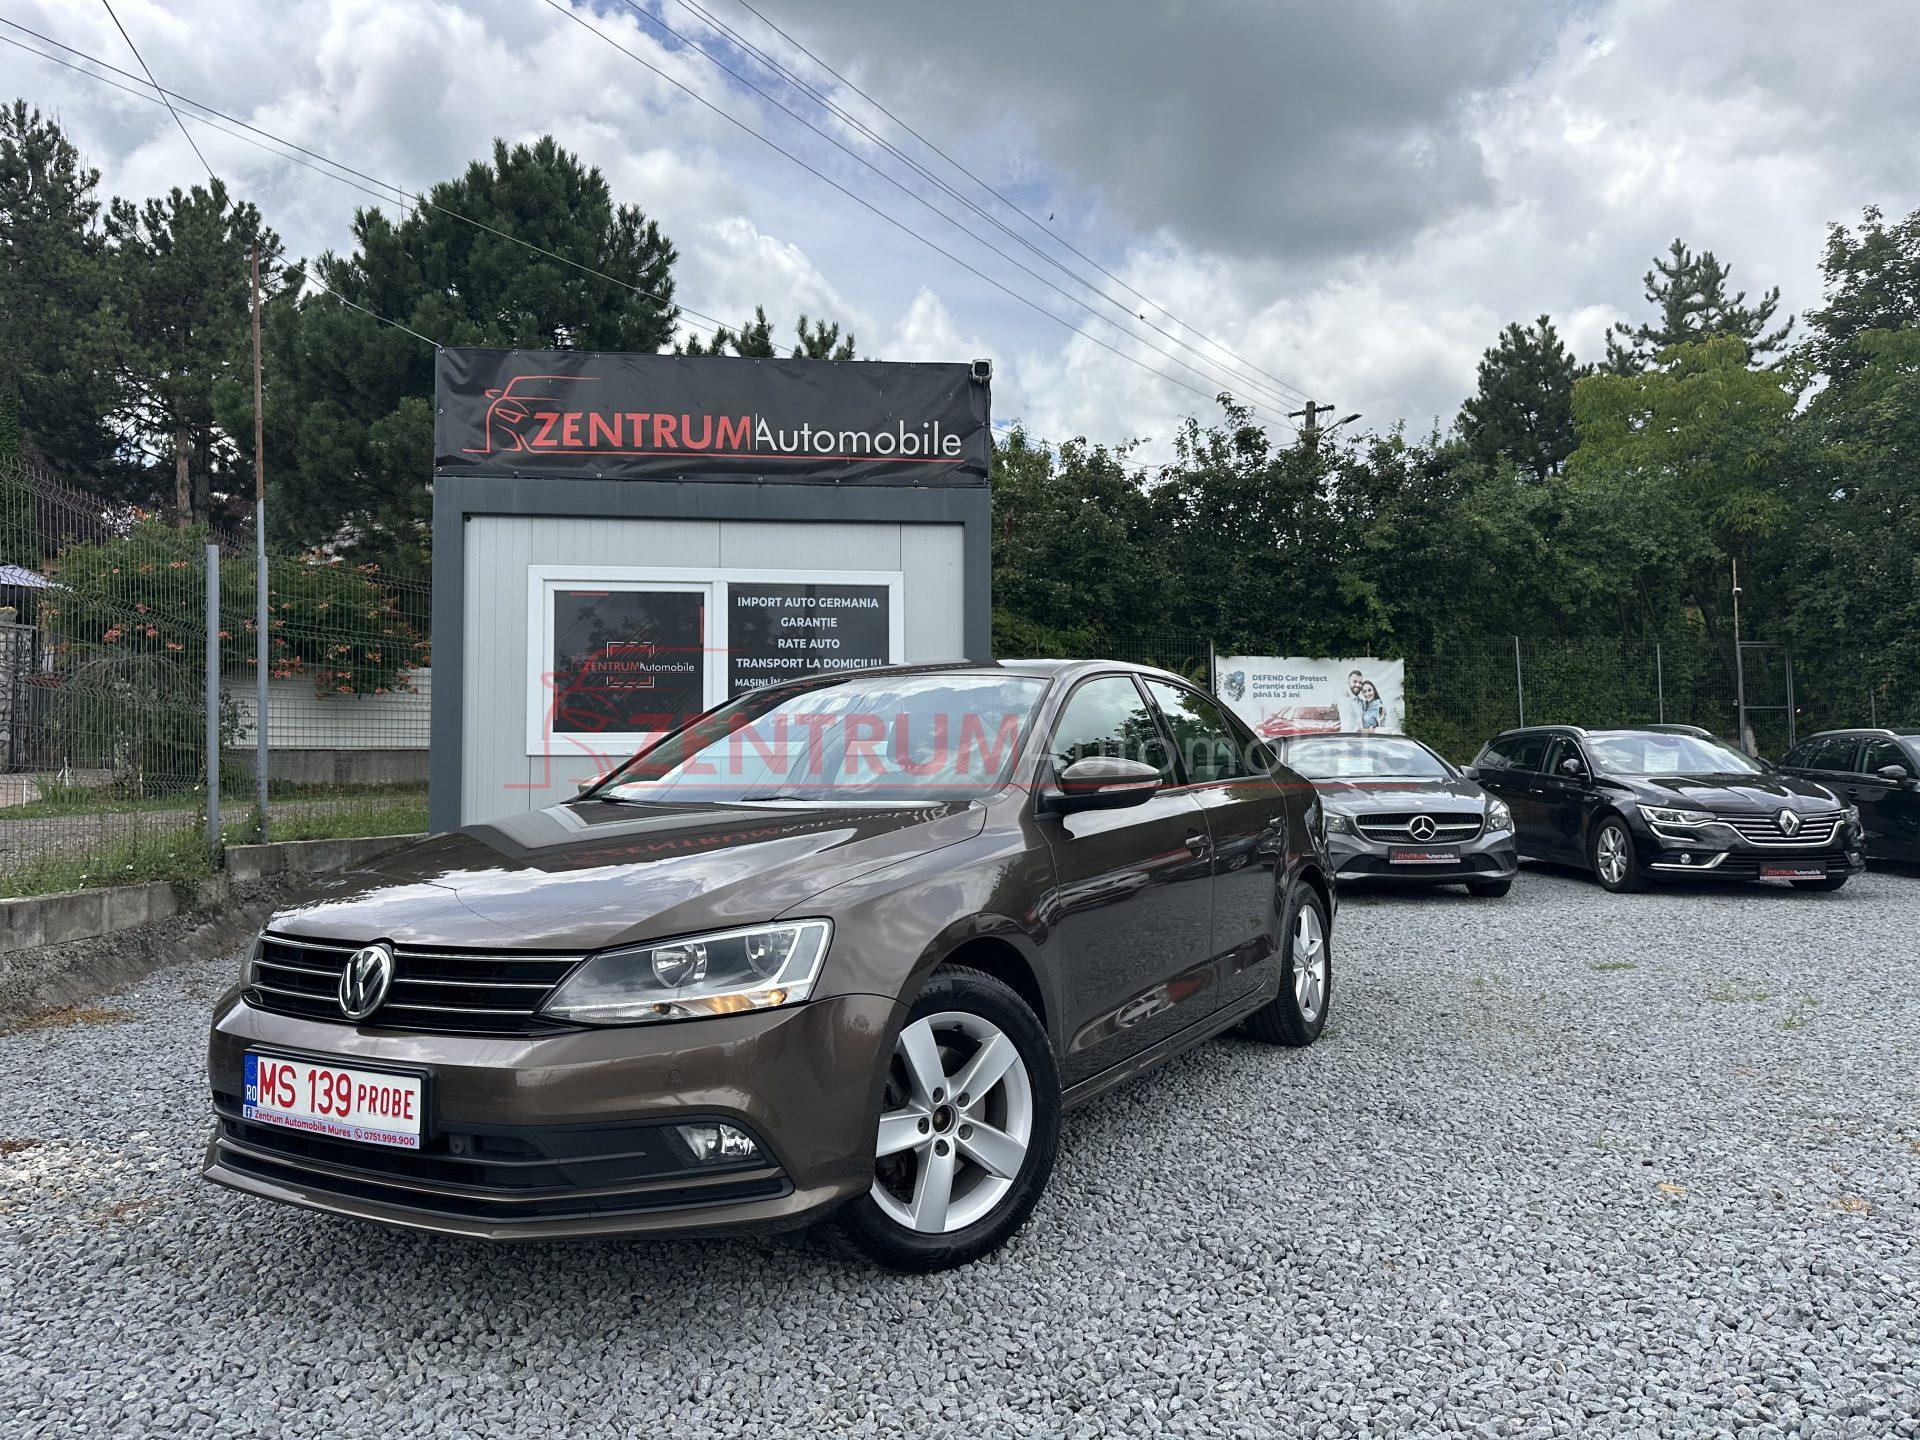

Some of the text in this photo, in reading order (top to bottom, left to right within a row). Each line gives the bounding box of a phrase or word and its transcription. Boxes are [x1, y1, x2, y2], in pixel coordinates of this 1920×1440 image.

[531, 411, 963, 456] ZENTRUM Automobile
[737, 597, 879, 608] IMPORT AUTO GERMANIA
[780, 617, 838, 630] GARANȚIE
[777, 638, 840, 649] RATE AUTO
[583, 661, 695, 672] ZENTRUM Automobile
[736, 658, 803, 668] TRANSPORT
[806, 658, 821, 668] LA
[1252, 674, 1284, 682] DEFEND
[246, 1084, 257, 1101] RO
[259, 1061, 415, 1120] MS 139 PROBE
[254, 1109, 283, 1124] Zentrum
[284, 1117, 327, 1133] Automobile
[327, 1125, 351, 1138] Mures
[363, 1131, 415, 1146] 0751.999.900
